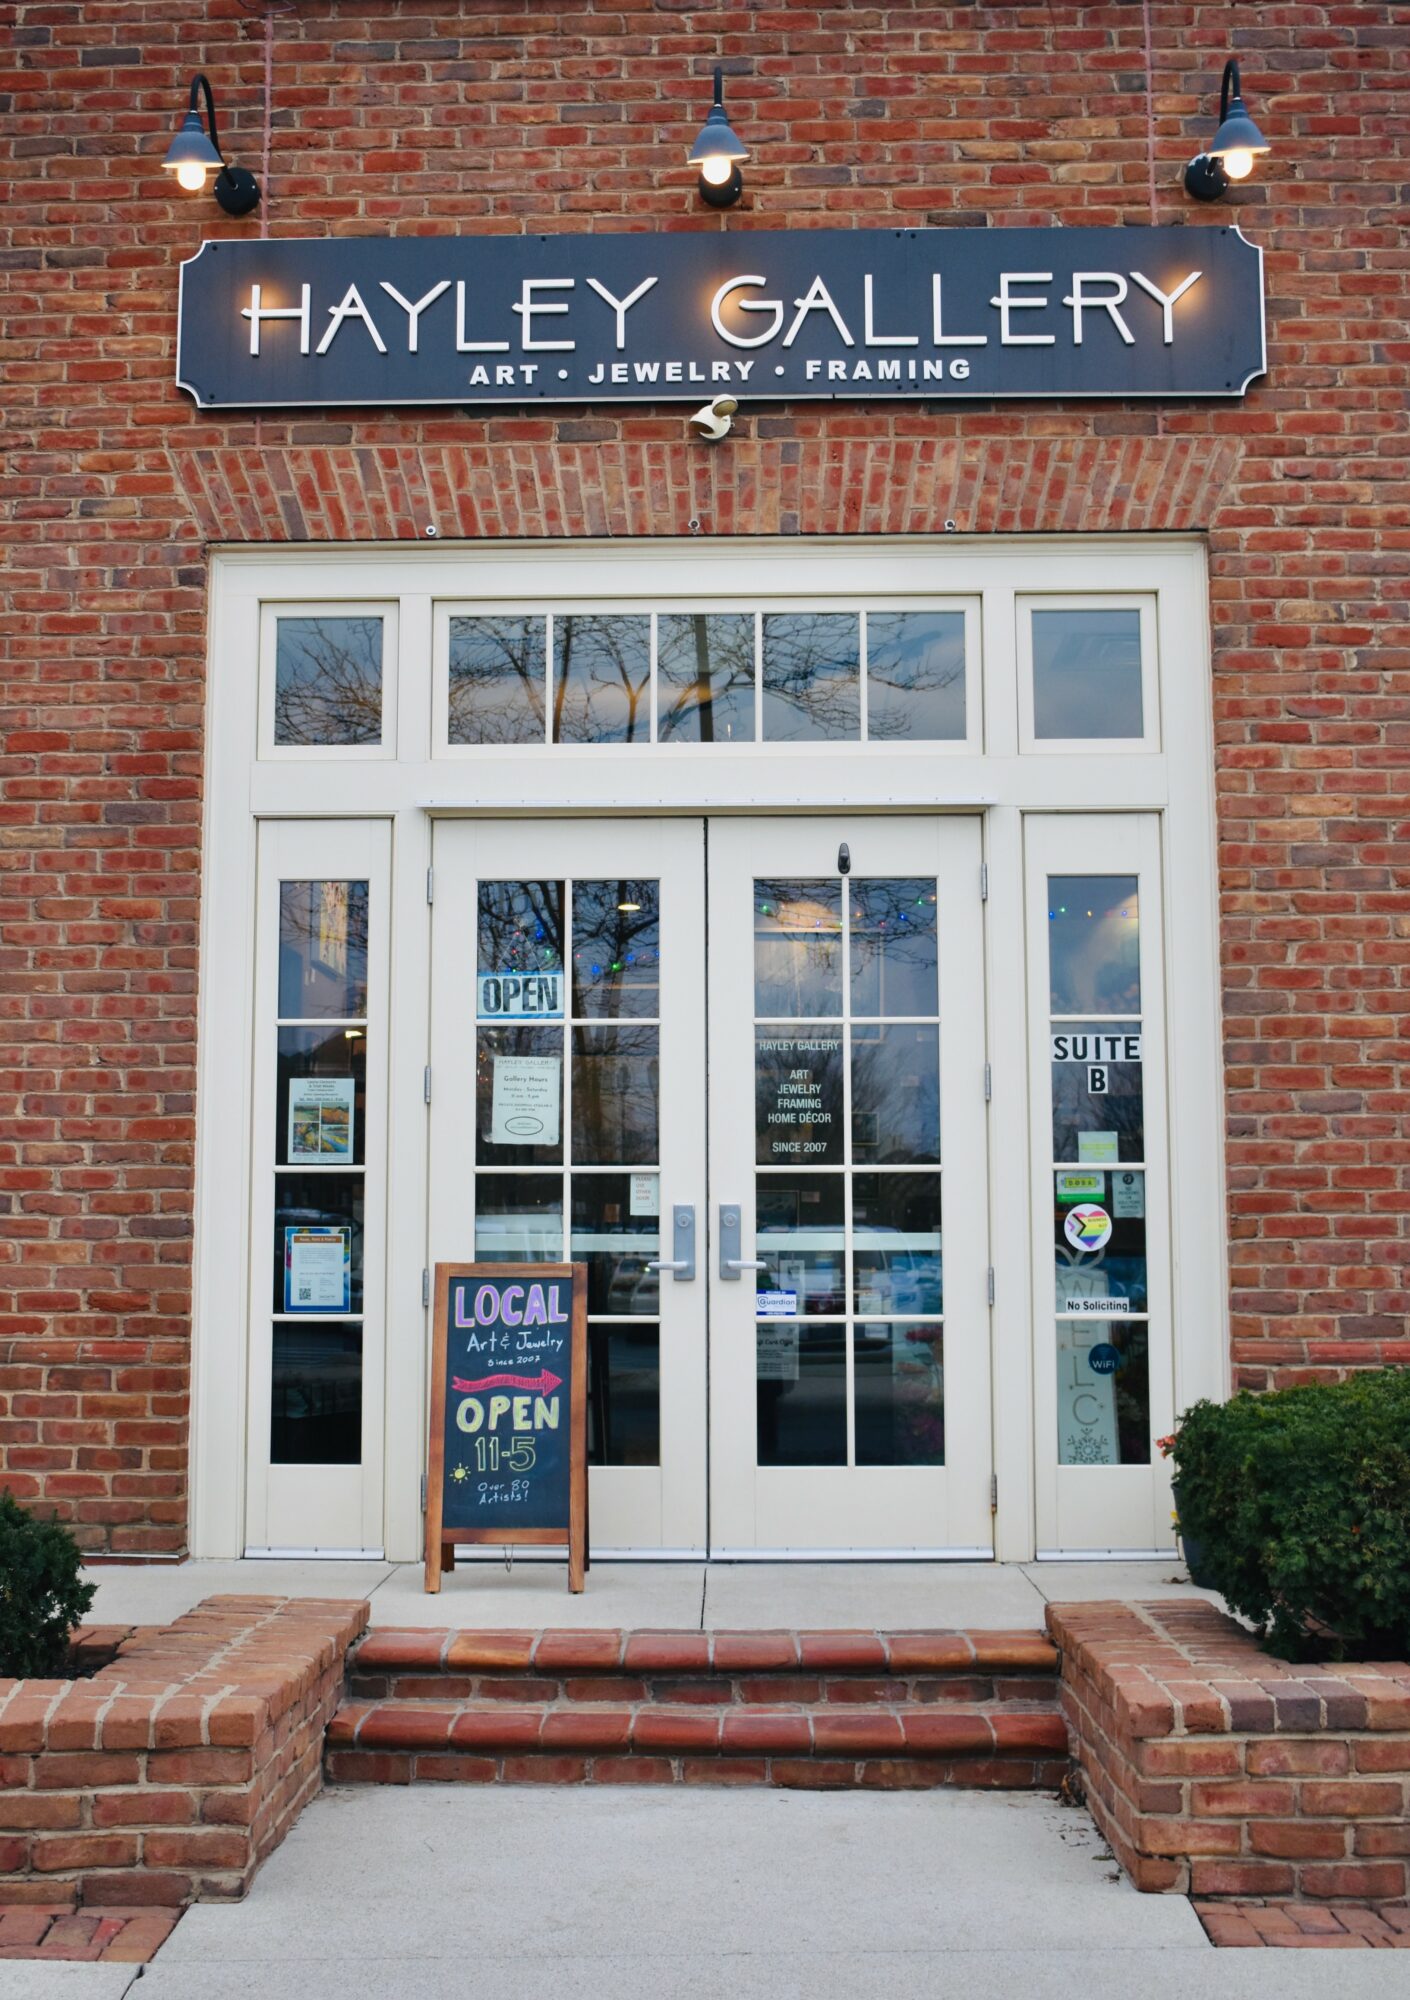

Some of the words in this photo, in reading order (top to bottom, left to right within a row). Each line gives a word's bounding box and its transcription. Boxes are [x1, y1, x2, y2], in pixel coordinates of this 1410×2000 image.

[241, 276, 659, 356] HAYLEY
[711, 271, 1203, 349] GALLERY
[469, 364, 539, 386] ART
[587, 361, 755, 385] JEWELRY
[806, 358, 972, 382] FRAMING
[482, 976, 558, 1014] OPEN
[759, 1040, 794, 1050] HAYLEY
[797, 1040, 839, 1050] GALLERY
[1053, 1035, 1140, 1060] SUITE
[789, 1069, 809, 1079] ART
[1090, 1067, 1106, 1092] B
[777, 1083, 822, 1094] JEWELRY
[777, 1098, 822, 1109] FRAMING
[767, 1112, 796, 1123] HOME
[799, 1110, 832, 1123] DÉCOR
[772, 1142, 801, 1152] SINCE
[803, 1142, 828, 1152] 2007
[455, 1284, 569, 1328] LOCAL
[758, 1296, 795, 1307] Guardian
[1067, 1300, 1080, 1310] No
[1083, 1300, 1128, 1312] Soliciting
[466, 1330, 498, 1352] Art
[500, 1332, 511, 1350] &
[515, 1330, 564, 1352] Jewelry
[516, 1355, 541, 1364] 2007
[1092, 1359, 1115, 1369] WiFi
[456, 1395, 560, 1433] OPEN
[474, 1436, 536, 1472] 11-5
[477, 1482, 505, 1492] Over
[511, 1479, 530, 1491] 80
[478, 1489, 529, 1505] Artists!
